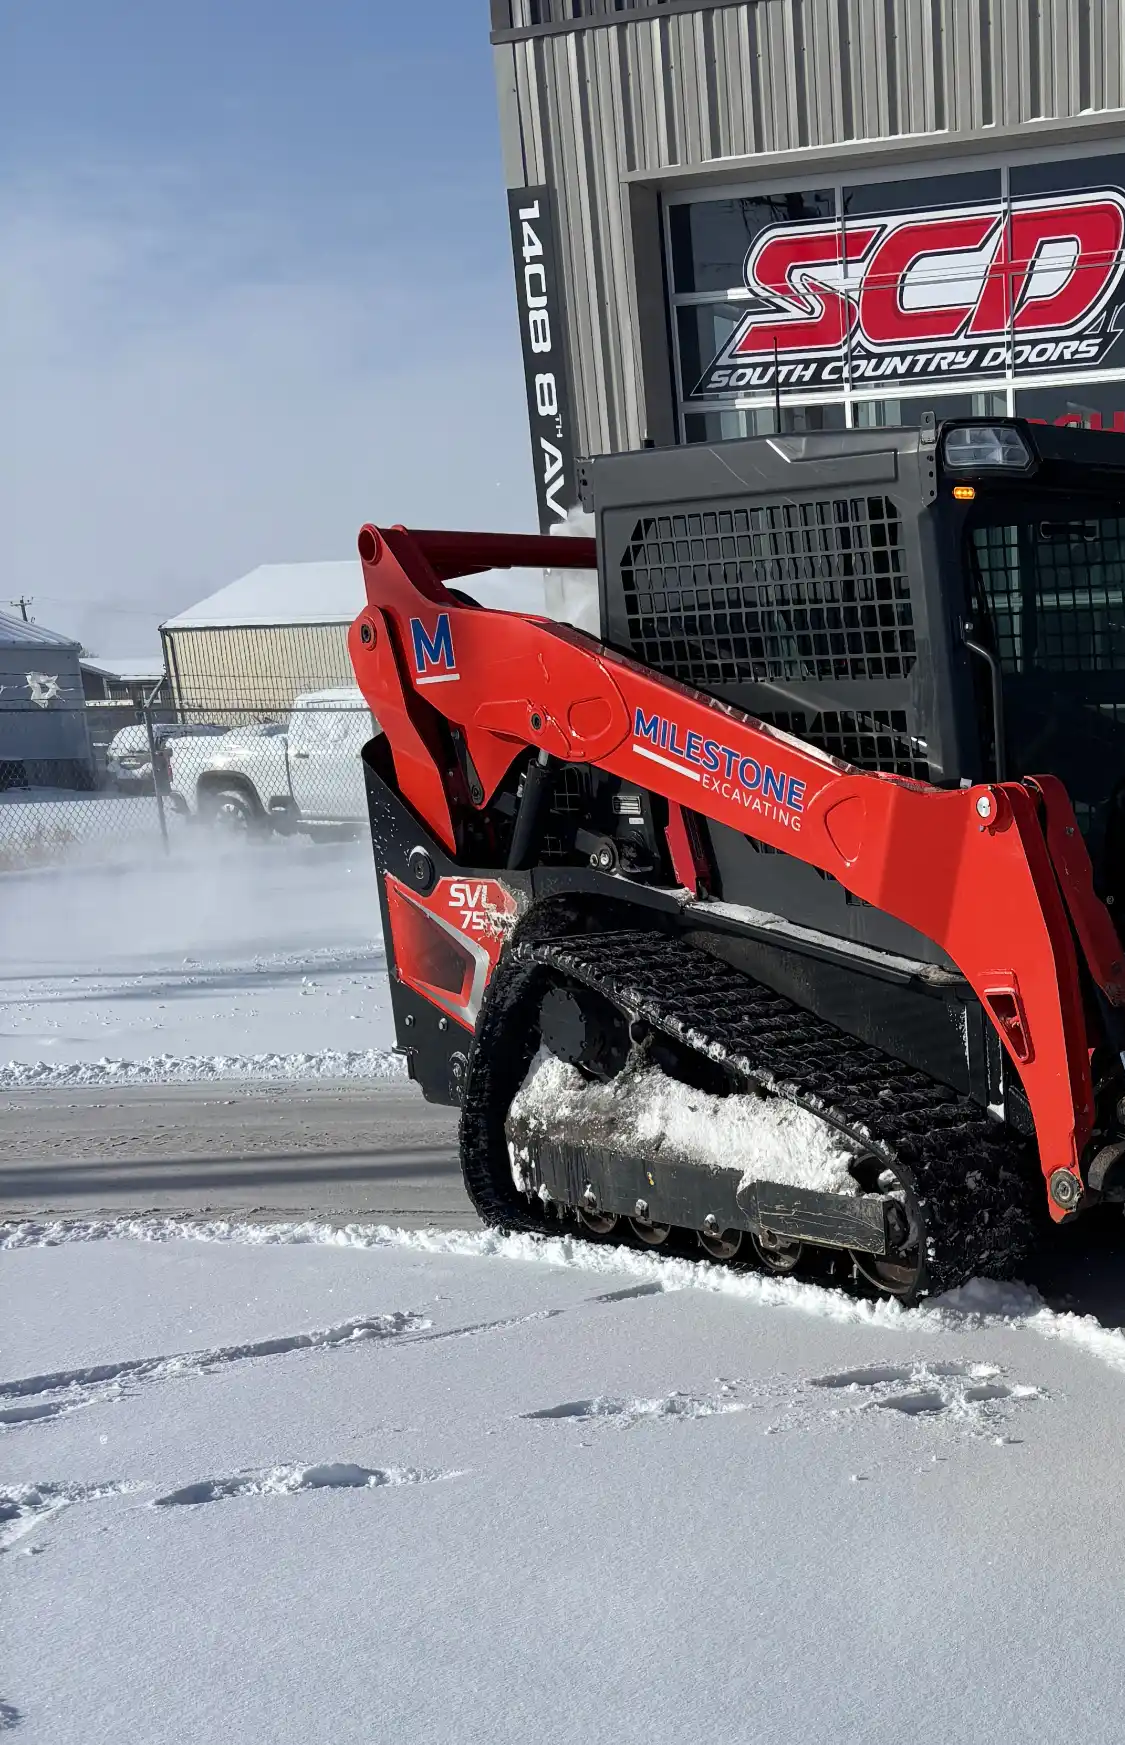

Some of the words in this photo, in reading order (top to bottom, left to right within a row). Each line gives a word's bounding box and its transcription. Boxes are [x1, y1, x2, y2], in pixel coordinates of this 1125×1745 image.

[518, 199, 552, 354] 1408
[706, 365, 813, 389] SOUTH
[821, 351, 972, 381] COUNTRY
[980, 337, 1103, 368] DOORS
[409, 612, 456, 673] M
[633, 706, 807, 813] MILESTONE
[702, 774, 802, 832] EXCAVATING
[448, 883, 496, 909] SVL
